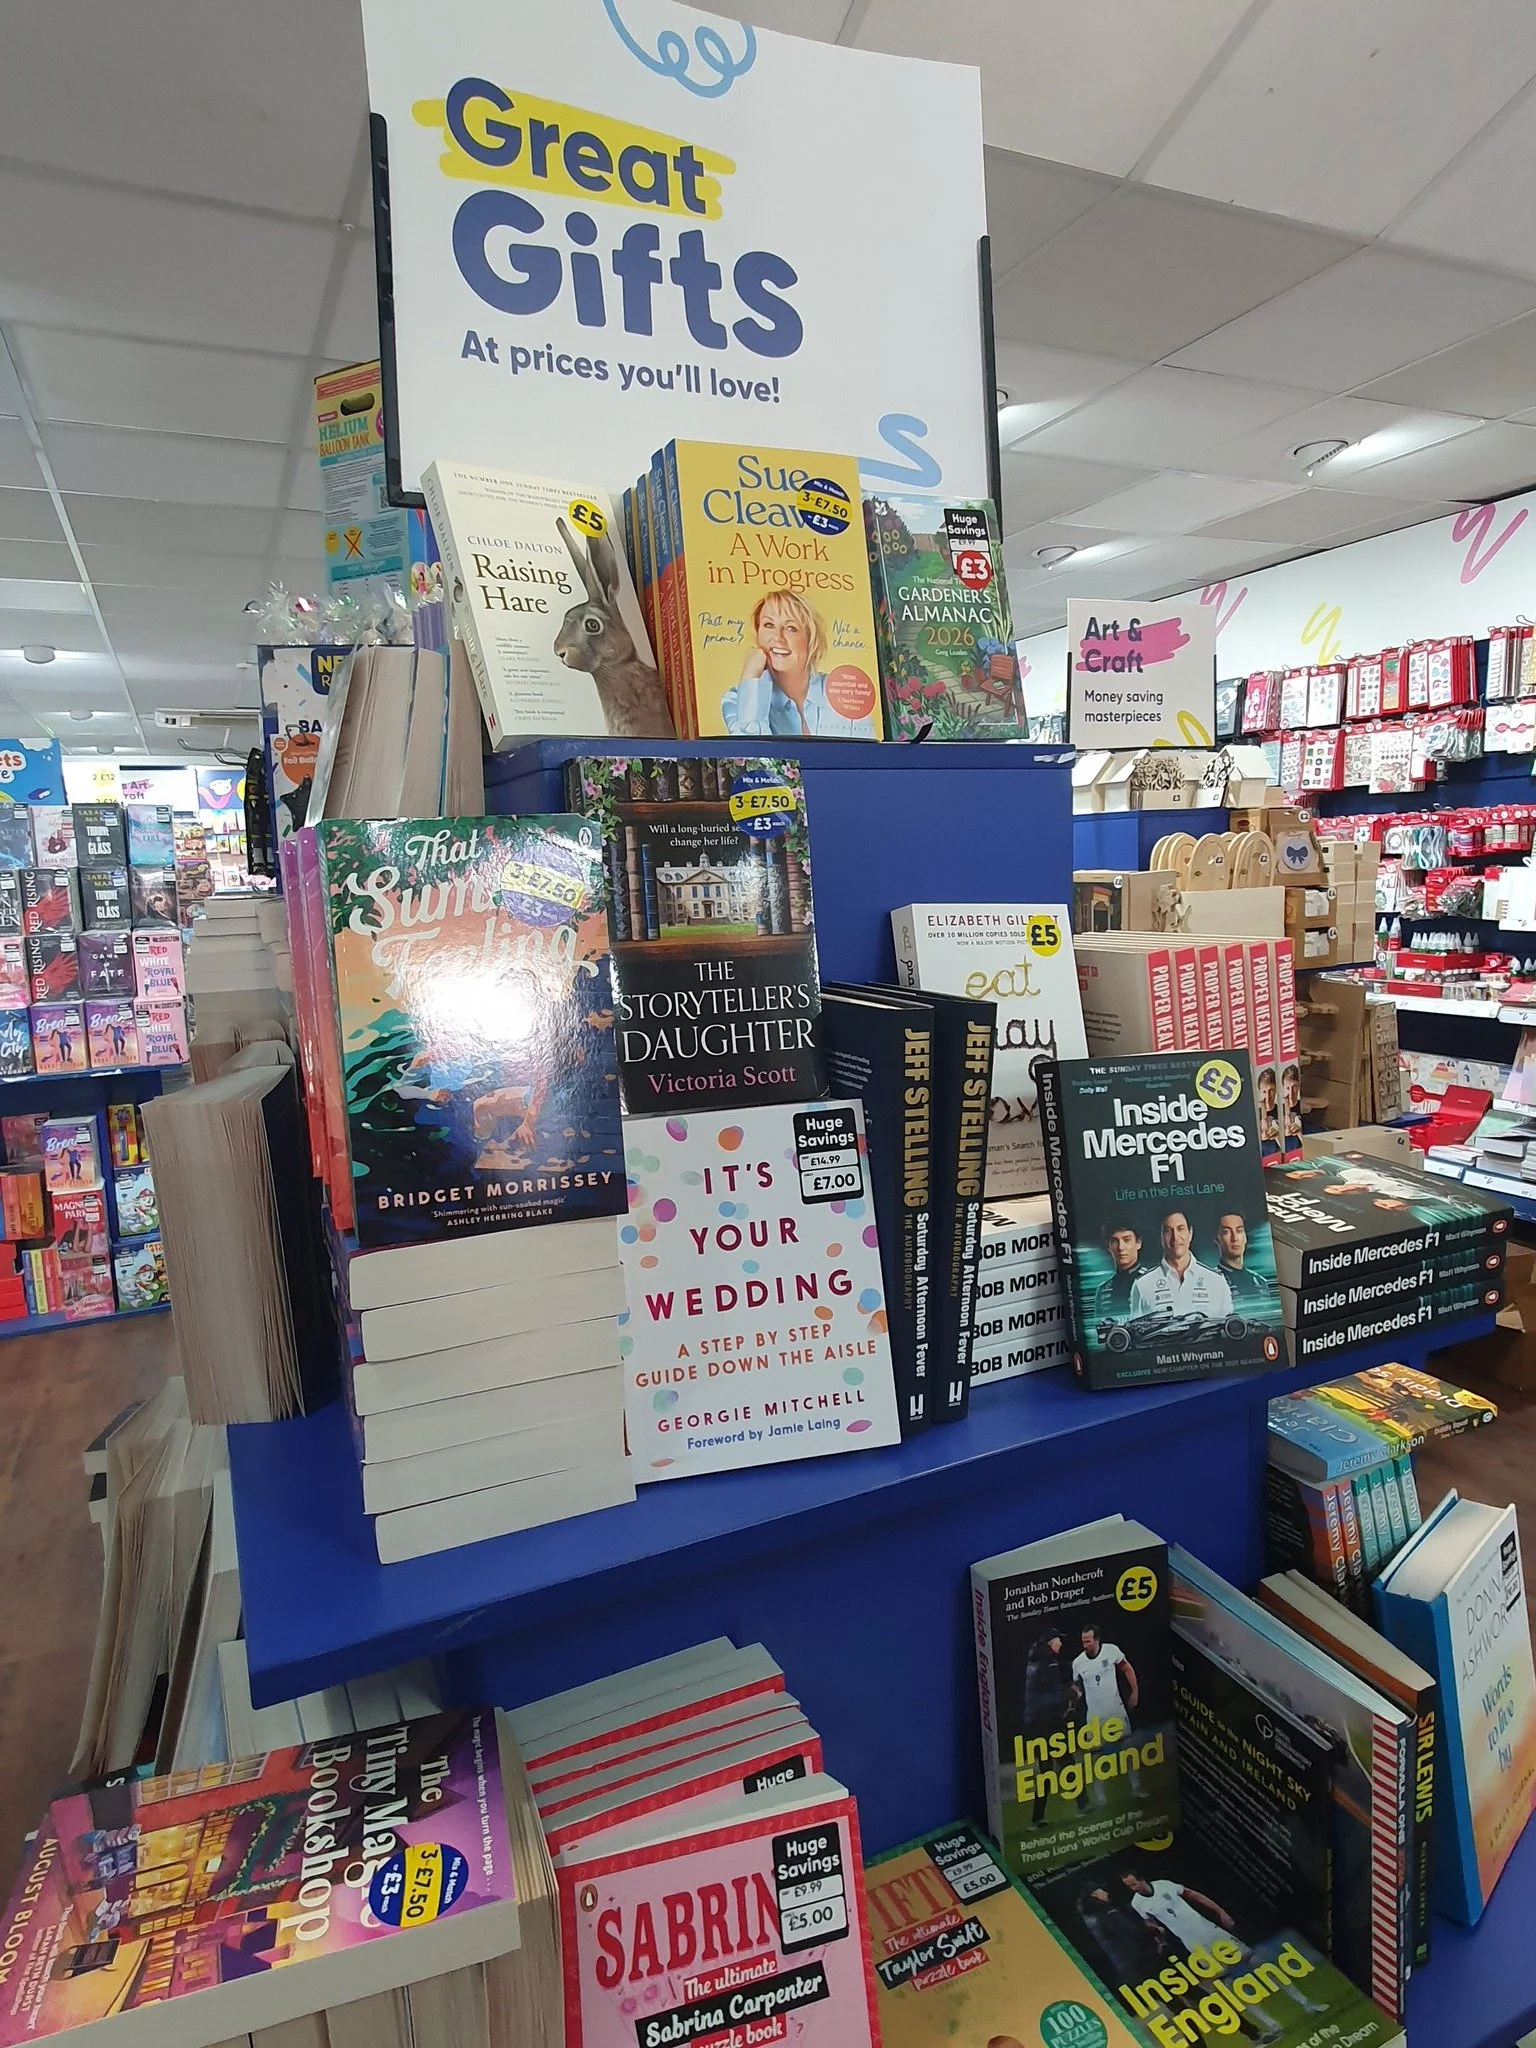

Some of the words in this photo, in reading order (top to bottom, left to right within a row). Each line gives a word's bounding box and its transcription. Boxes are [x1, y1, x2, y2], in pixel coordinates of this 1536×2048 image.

[445, 77, 706, 215] Great
[451, 189, 804, 359] Gifts
[460, 329, 500, 365] At
[511, 342, 610, 382] prices
[618, 359, 701, 395] you'll
[710, 367, 781, 404] love!
[319, 416, 368, 441] HELIUM
[352, 432, 370, 449] TANK
[738, 454, 809, 492] Sue
[572, 504, 603, 531] £5
[703, 489, 805, 529] Cleav
[952, 513, 978, 526] Huge
[467, 536, 510, 549] CHLOE
[513, 541, 563, 555] DALTON
[730, 533, 750, 557] A
[757, 534, 830, 562] Work
[948, 525, 986, 538] Savings
[470, 553, 572, 594] Raising
[708, 560, 735, 584] in
[743, 561, 855, 593] Progress
[961, 559, 988, 580] £3
[480, 585, 550, 614] Hare
[898, 587, 992, 604] GARDENER'S
[902, 605, 993, 623] ALMANAC
[1085, 617, 1120, 642] Art
[1127, 618, 1142, 642] &
[925, 626, 975, 648] 2026
[1085, 649, 1143, 673] Craft
[1084, 690, 1123, 706] Money
[1126, 690, 1164, 706] saving
[1084, 710, 1162, 725] masterpieces
[405, 828, 484, 871] That
[670, 838, 702, 848] change
[704, 837, 719, 846] her
[720, 837, 739, 846] life?
[24, 871, 41, 907] RISING
[29, 911, 43, 933] RED
[1031, 925, 1058, 946] £5
[30, 938, 46, 975] RISING
[140, 957, 170, 967] WHITE
[149, 945, 168, 955] RED
[145, 968, 176, 978] ROYAL
[150, 978, 171, 987] BLUE
[694, 961, 735, 982] THE
[965, 955, 1041, 998] eat
[1252, 956, 1271, 1004] PROPER
[1278, 953, 1295, 1001] PROPER
[35, 978, 50, 1000] RED
[620, 983, 811, 1020] STORYTELLER'S
[141, 1022, 172, 1033] WHITE
[151, 1012, 170, 1020] RED
[1255, 1005, 1275, 1058] HEALTHY
[1279, 1001, 1297, 1055] HEALTHY
[146, 1033, 178, 1044] ROYAL
[152, 1044, 173, 1053] BLUE
[622, 1018, 815, 1063] DAUGHTER
[904, 1028, 931, 1082] JEFF
[965, 1020, 992, 1074] JEFF
[647, 1071, 737, 1094] Victoria
[743, 1065, 796, 1086] Scott
[1199, 1068, 1238, 1100] £5
[1042, 1073, 1059, 1132] Inside
[1114, 1094, 1208, 1127] Inside
[798, 1132, 855, 1148] Savings
[806, 1118, 844, 1131] Huge
[956, 1078, 987, 1197] STELLING
[904, 1086, 931, 1207] STELLING
[1083, 1125, 1246, 1159] Mercedes
[704, 1161, 773, 1195] IT'S
[1151, 1154, 1185, 1183] F1
[378, 1185, 475, 1210] BRIDGET
[487, 1171, 612, 1198] MORRISSEY
[1049, 1137, 1068, 1239] Mercedes
[1115, 1190, 1135, 1201] Life
[1137, 1189, 1147, 1199] in
[1149, 1187, 1168, 1198] the
[1171, 1184, 1196, 1197] Fast
[1198, 1182, 1225, 1194] Lane
[447, 1216, 481, 1227] ASHLEY
[483, 1212, 523, 1223] HERRING
[526, 1208, 553, 1219] BLAKE
[962, 1202, 980, 1260] Saturday
[689, 1217, 800, 1254] YOUR
[914, 1212, 930, 1271] Saturday
[1060, 1242, 1073, 1266] F1
[645, 1269, 853, 1322] WEDDING
[916, 1276, 930, 1340] Afternoon
[959, 1264, 976, 1328] Afternoon
[678, 1344, 690, 1359] A
[701, 1335, 745, 1357] STEP
[757, 1330, 778, 1347] BY
[789, 1324, 832, 1343] STEP
[957, 1330, 970, 1366] Fever
[1156, 1354, 1180, 1365] Matt
[1182, 1350, 1224, 1363] Whyman
[635, 1365, 698, 1388] GUIDE
[708, 1355, 769, 1378] DOWN
[779, 1349, 814, 1366] THE
[825, 1340, 877, 1360] AISLE
[915, 1342, 929, 1378] Fever
[658, 1407, 752, 1433] GEORGIE
[764, 1390, 865, 1415] MITCHELL
[687, 1429, 745, 1450] Foreword
[749, 1425, 763, 1442] by
[768, 1420, 805, 1437] Jamie
[808, 1417, 841, 1435] Laing
[1336, 1452, 1376, 1474] Jeremy
[1378, 1435, 1425, 1459] Clarkson
[1360, 1487, 1373, 1541] Jeremy
[1004, 1581, 1049, 1601] Jonathan
[1051, 1568, 1104, 1588] Northcroft
[1006, 1600, 1025, 1611] and
[1027, 1594, 1048, 1607] Rob
[1051, 1586, 1085, 1603] Draper
[1120, 1576, 1152, 1600] £5
[1014, 1714, 1124, 1768] Inside
[1181, 1687, 1215, 1723] GUIDE
[1242, 1738, 1283, 1780] NIGHT
[1287, 1775, 1312, 1802] SKY
[1418, 1711, 1435, 1752] SIR
[349, 1727, 409, 1796] Tiny
[1016, 1732, 1164, 1803] England
[420, 1755, 450, 1803] The
[756, 1767, 795, 1792] Huge
[1415, 1751, 1434, 1823] LEWIS
[280, 1744, 351, 1942] Bookshop
[786, 1835, 828, 1857] Huge
[935, 1834, 966, 1852] Huge
[935, 1842, 982, 1867] Savings
[21, 1838, 58, 1904] AUGUST
[343, 1796, 409, 1928] Magc
[777, 1853, 840, 1881] Savings
[963, 1873, 997, 1893] £5.00
[595, 1869, 781, 1990] SABRIN
[0, 1909, 33, 1985] BLOOM
[879, 1946, 935, 1982] Taylor
[936, 1922, 986, 1957] Swift
[685, 1977, 713, 2000] The
[714, 1957, 776, 1991] ultimate
[1119, 1939, 1243, 2020] Inside
[1147, 1941, 1316, 2048] England
[646, 2009, 725, 2048] Sabrina
[729, 1975, 823, 2018] Carpenter
[1045, 2004, 1087, 2035] 100
